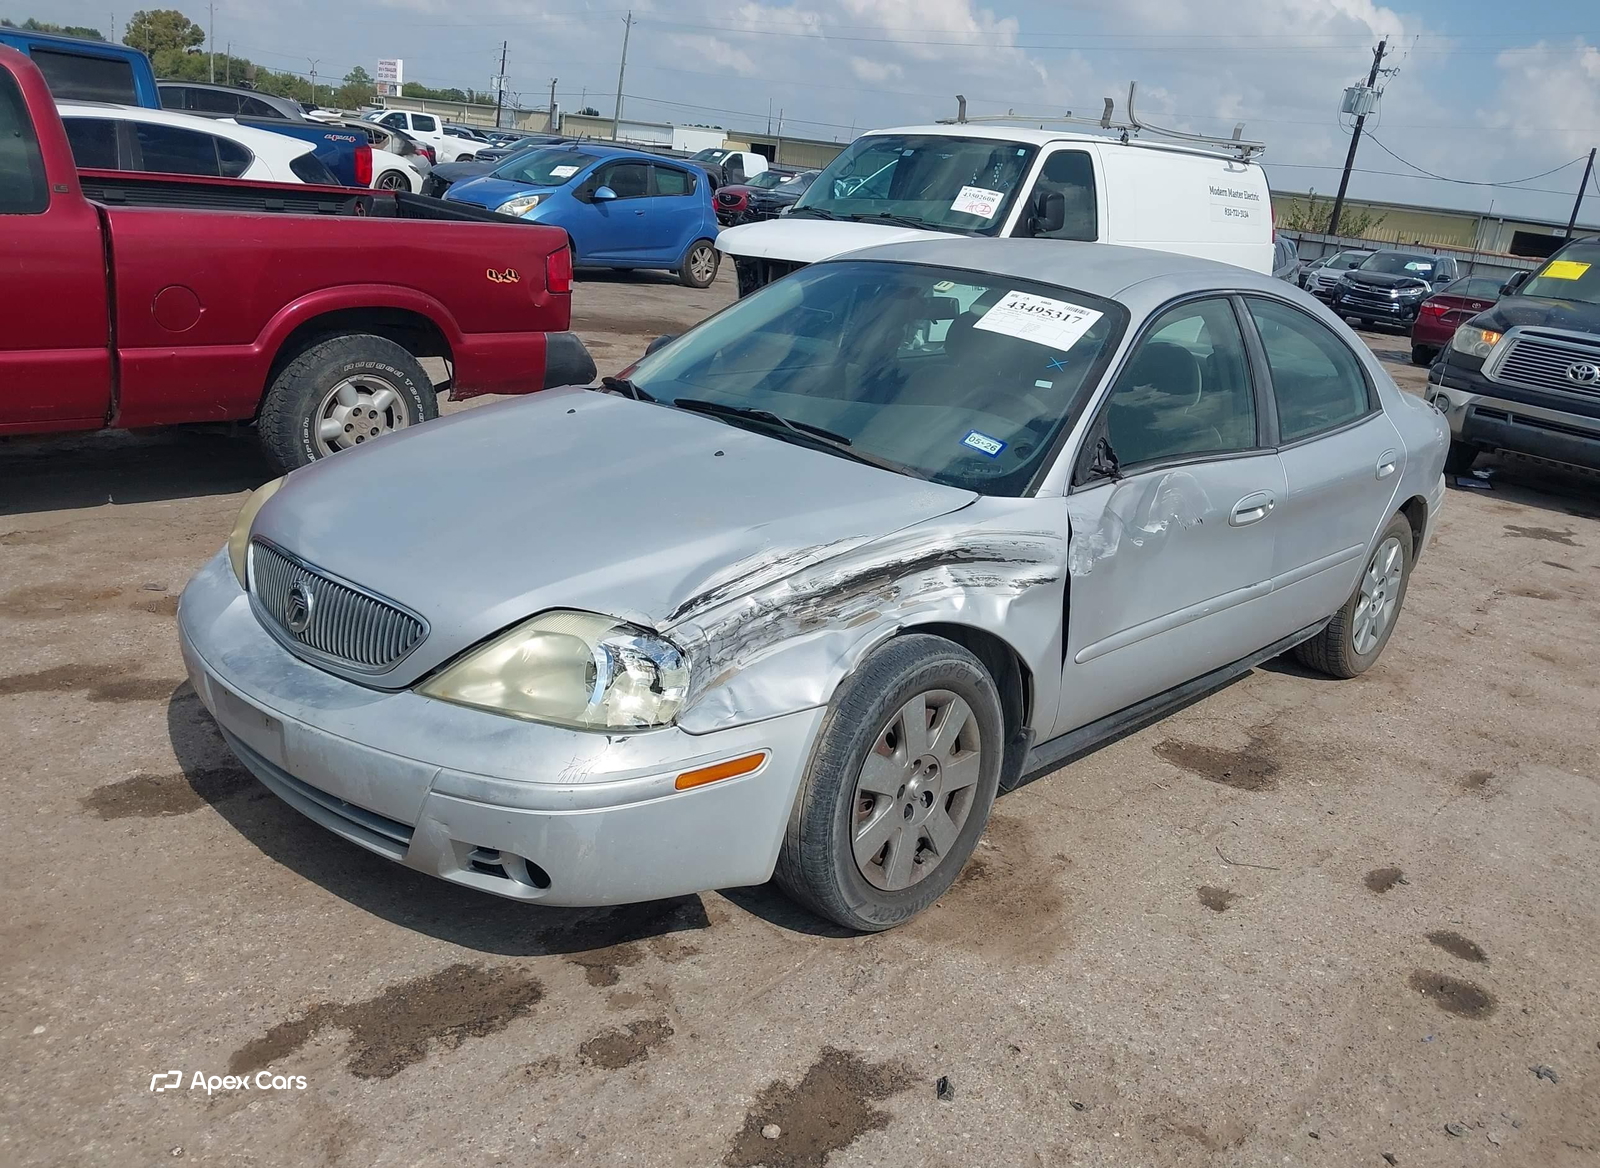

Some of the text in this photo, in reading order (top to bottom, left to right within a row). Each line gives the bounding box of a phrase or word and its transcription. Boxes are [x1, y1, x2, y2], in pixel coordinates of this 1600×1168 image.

[1209, 185, 1259, 201] Modern Master Electric
[486, 267, 521, 284] 4x4
[1006, 300, 1083, 325] 43495317
[343, 361, 425, 423] Rugged Terra
